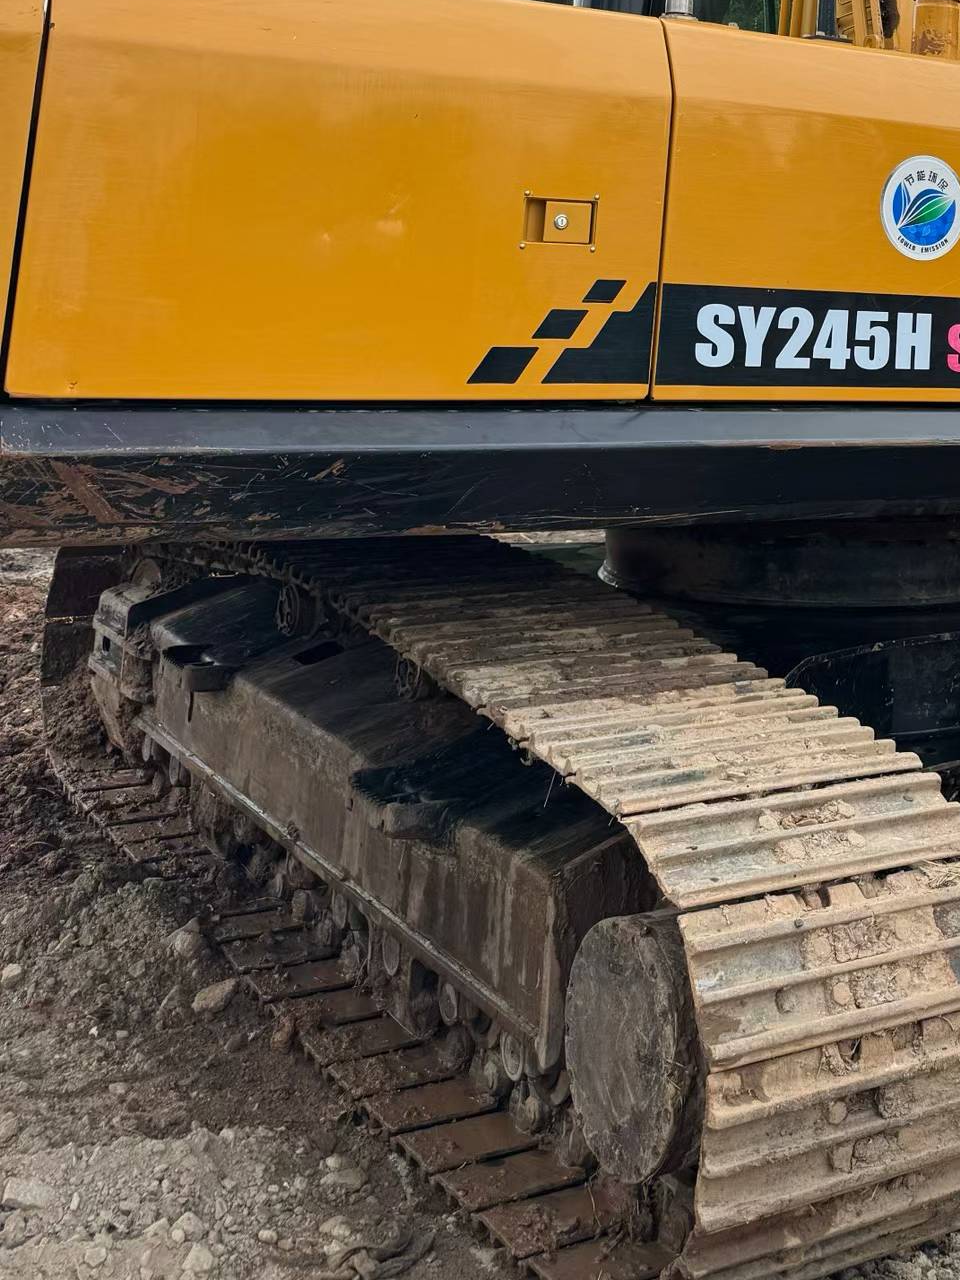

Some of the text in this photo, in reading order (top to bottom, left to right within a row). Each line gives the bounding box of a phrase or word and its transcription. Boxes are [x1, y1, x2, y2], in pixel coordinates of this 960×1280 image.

[904, 170, 949, 191] 节能环保
[920, 239, 949, 253] EMISSION
[695, 303, 932, 371] SY245H
